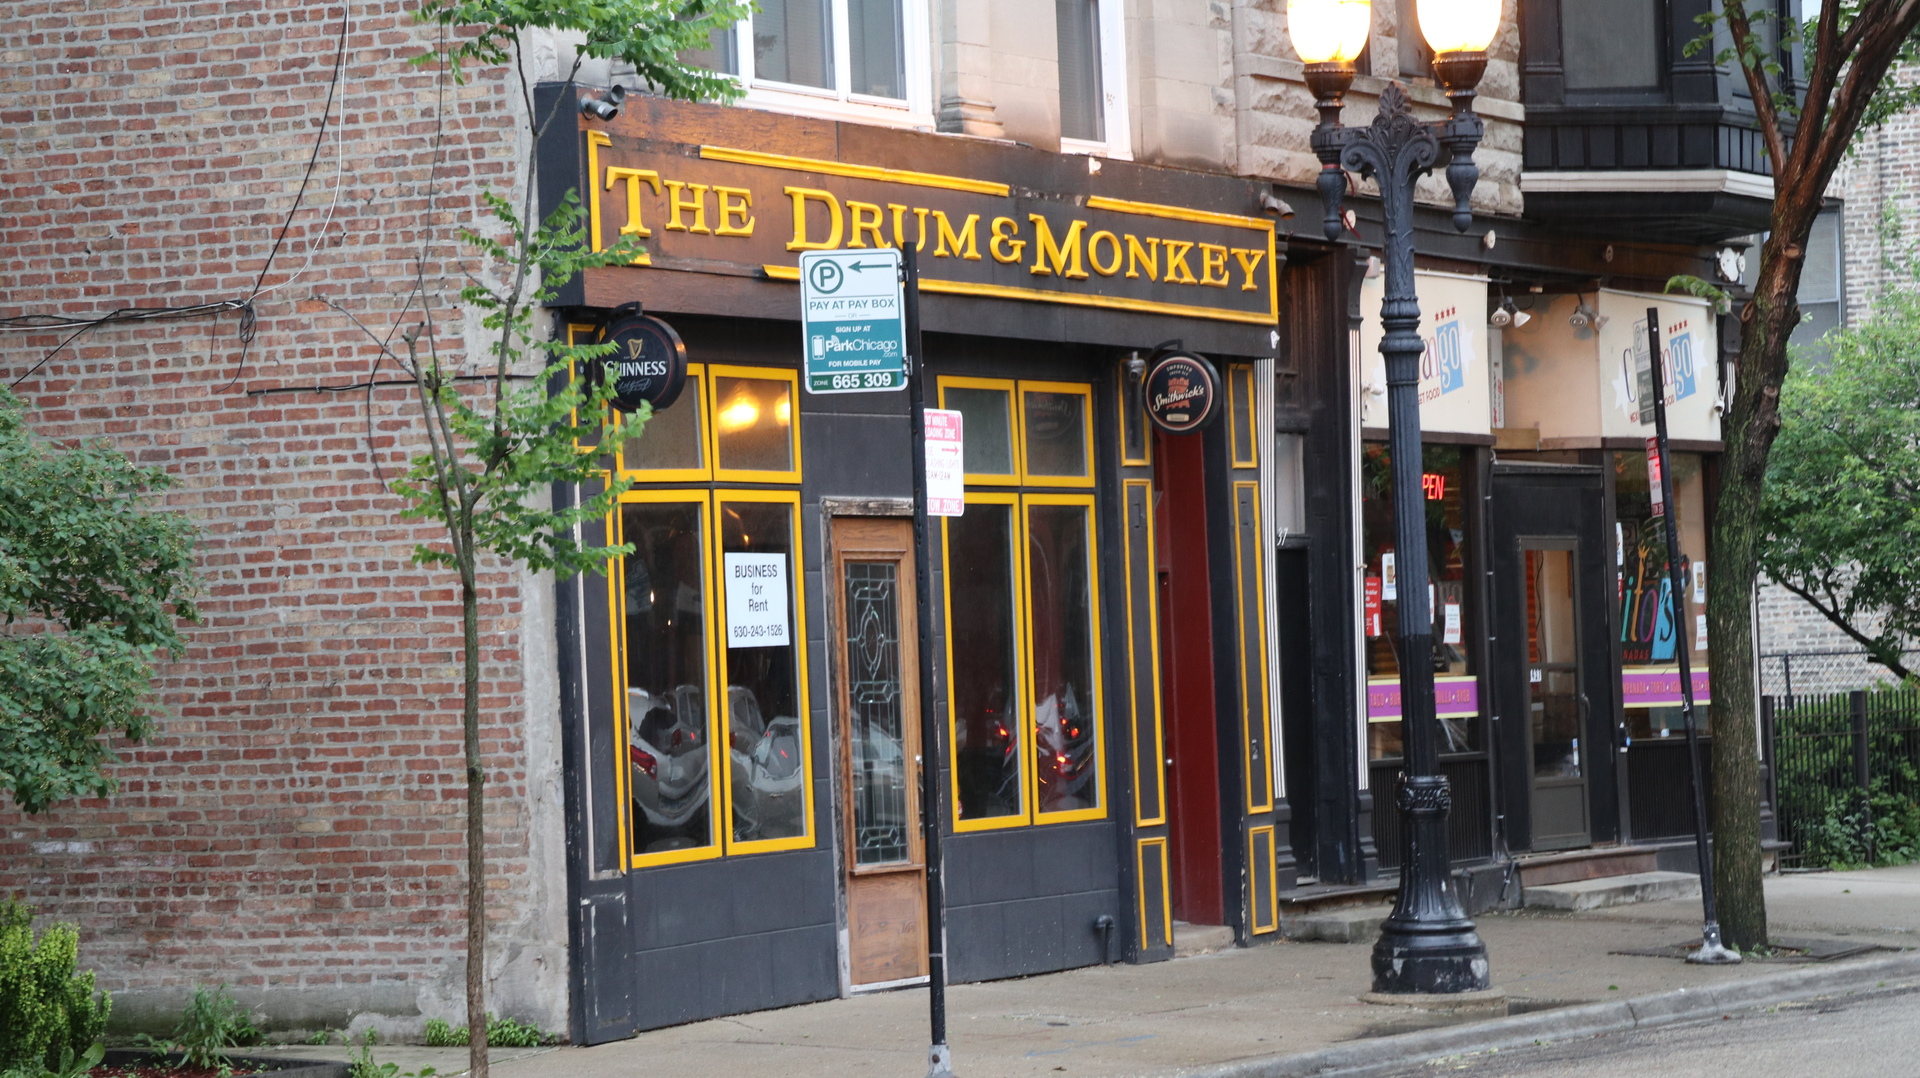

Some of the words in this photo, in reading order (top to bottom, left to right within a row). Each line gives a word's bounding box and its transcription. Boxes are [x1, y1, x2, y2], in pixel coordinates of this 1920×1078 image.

[605, 166, 756, 238] THE
[783, 186, 982, 261] DRUM
[1029, 213, 1266, 291] MONKEY
[809, 301, 830, 311] PAY
[832, 300, 846, 310] AT
[848, 299, 869, 309] PAY
[871, 298, 895, 308] BOX
[825, 338, 898, 353] ParkChicago
[832, 374, 860, 389] 665
[863, 372, 892, 388] 309
[1153, 384, 1205, 412] Smithwick's
[931, 415, 948, 427] MINUTE
[944, 428, 956, 439] ZONE
[1422, 473, 1445, 500] PEN
[927, 498, 941, 512] TOW
[943, 499, 960, 513] ZONE
[735, 564, 778, 579] BUSINESS
[751, 582, 763, 595] for
[1620, 541, 1673, 642] ito's
[748, 599, 769, 612] Rent
[733, 624, 783, 638] 630-243-1526
